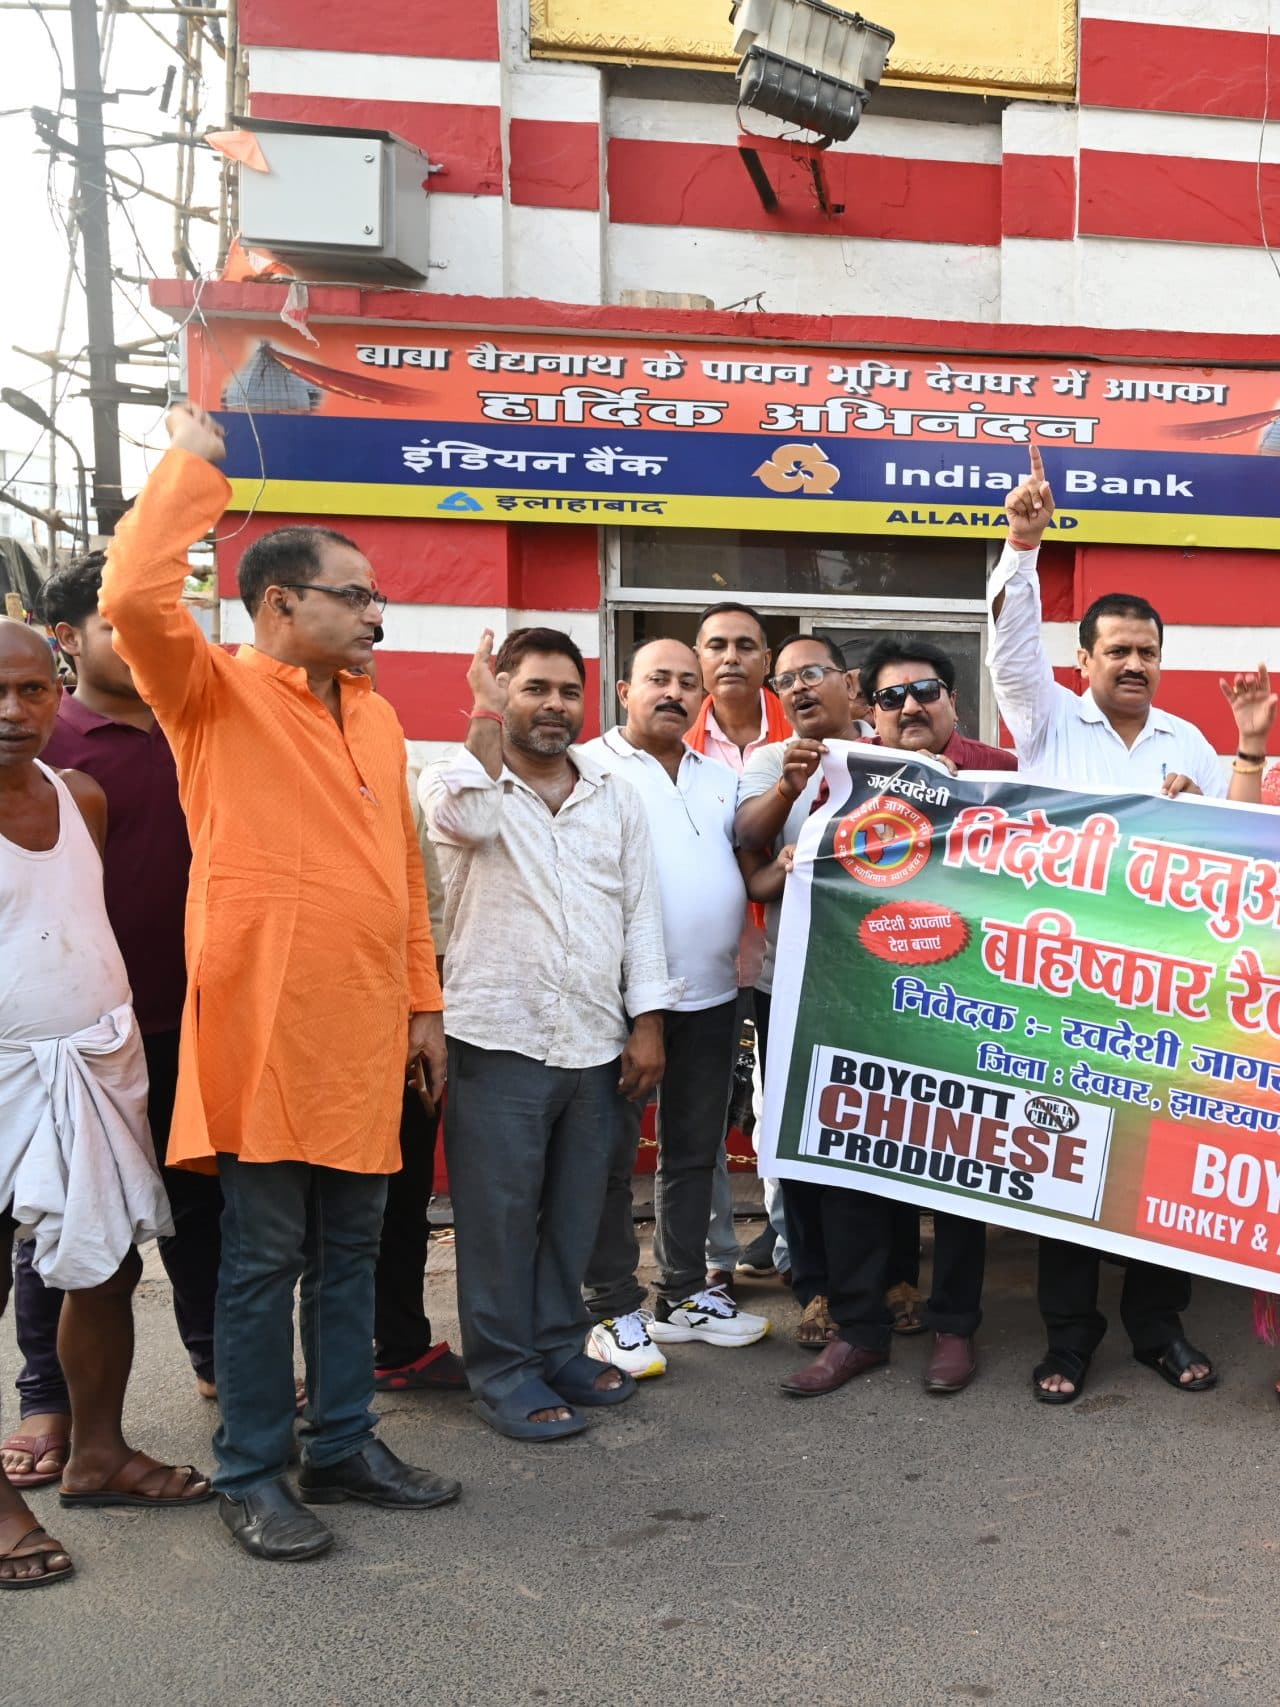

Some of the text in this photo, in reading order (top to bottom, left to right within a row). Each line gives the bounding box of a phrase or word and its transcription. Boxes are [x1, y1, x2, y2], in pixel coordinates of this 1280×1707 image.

[355, 341, 1229, 405] बाबा बैद्यनाथ के पावन भूमि देवघर में आपका
[478, 386, 1100, 444] हार्दिक अभिनंदन
[401, 438, 668, 478] इंडियन बैंक
[1066, 470, 1194, 498] Bank
[496, 492, 668, 516] इलाहाबाद
[890, 772, 951, 808] स्वदेशी
[942, 806, 1119, 895] विदेशी
[867, 914, 906, 933] स्वदेशी
[888, 935, 909, 953] देश
[980, 908, 1216, 1022] बहिष्कार
[892, 975, 1017, 1035] निवेदक
[1060, 1016, 1184, 1069] स्वदेशी
[829, 1054, 1016, 1121] BOYCOTT
[976, 1041, 1047, 1084] जिला
[818, 1083, 1088, 1184] CHINESE
[1027, 1109, 1074, 1130] CHINA
[818, 1127, 1035, 1201] PRODUCTS
[1146, 1195, 1245, 1245] TURKEY
[1250, 1223, 1269, 1253] &
